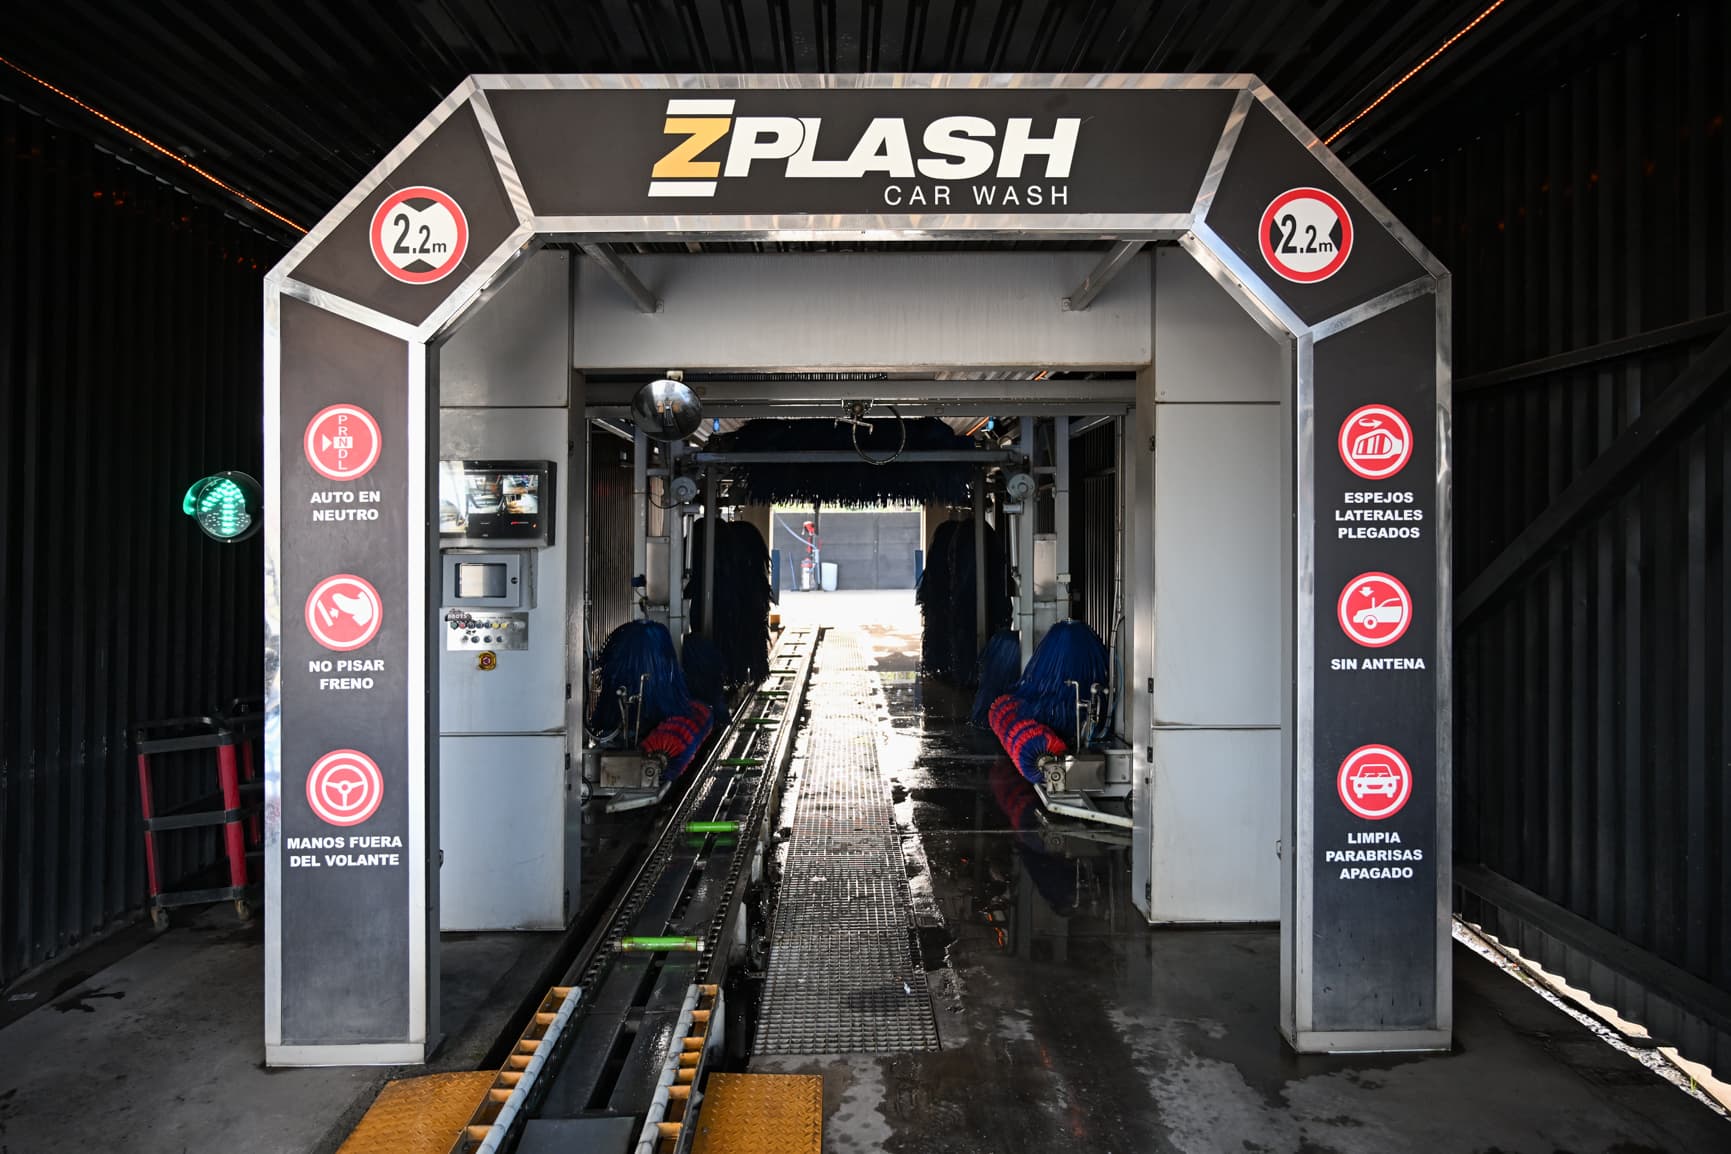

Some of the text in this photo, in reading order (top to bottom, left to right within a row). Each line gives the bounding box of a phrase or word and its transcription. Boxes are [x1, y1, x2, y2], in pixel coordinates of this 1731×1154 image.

[651, 115, 1082, 180] ZPLASH
[884, 185, 1069, 206] CAR WASH
[310, 490, 381, 504] AUTO EN
[1344, 492, 1414, 504] ESPEJOS
[312, 508, 379, 522] NEUTRO
[1335, 509, 1423, 522] LATERALES
[1338, 527, 1421, 539] PLEGADOS
[308, 659, 385, 673] NO PISAR
[1330, 658, 1426, 670] SIN ANTENA
[319, 677, 374, 690] FRENO
[287, 836, 403, 850] MANOS FUERA
[1347, 832, 1401, 844] LIMPIA
[290, 853, 400, 868] DEL VOLANTE
[1325, 849, 1423, 862] PARABRISAS
[1339, 867, 1414, 880] APAGADO
